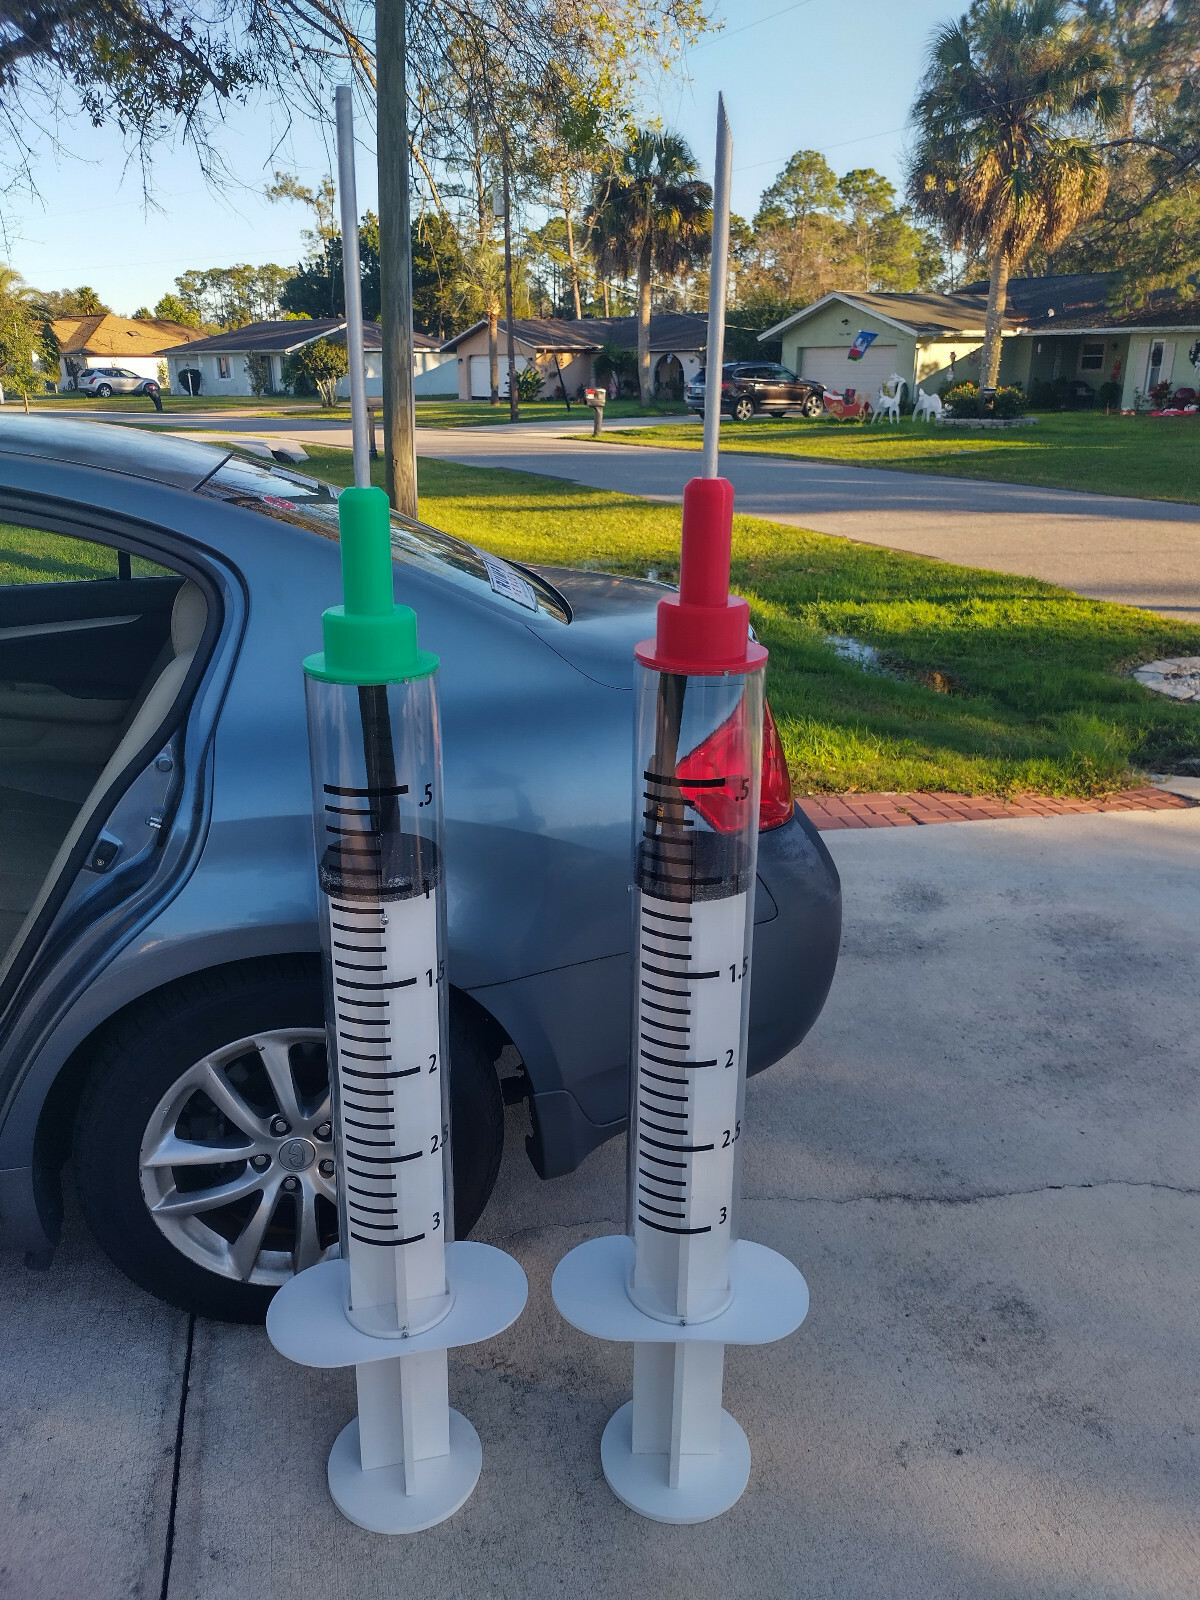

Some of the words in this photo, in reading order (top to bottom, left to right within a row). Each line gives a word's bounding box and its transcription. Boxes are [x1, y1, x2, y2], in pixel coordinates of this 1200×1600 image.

[419, 783, 433, 807] .5
[735, 778, 749, 801] .5
[422, 879, 430, 899] 1
[729, 956, 748, 983] 1.5
[428, 1053, 437, 1074] 2
[724, 1049, 734, 1068] 2
[721, 1120, 741, 1148] 2.5
[432, 1211, 441, 1231] 3
[719, 1207, 727, 1225] 3
